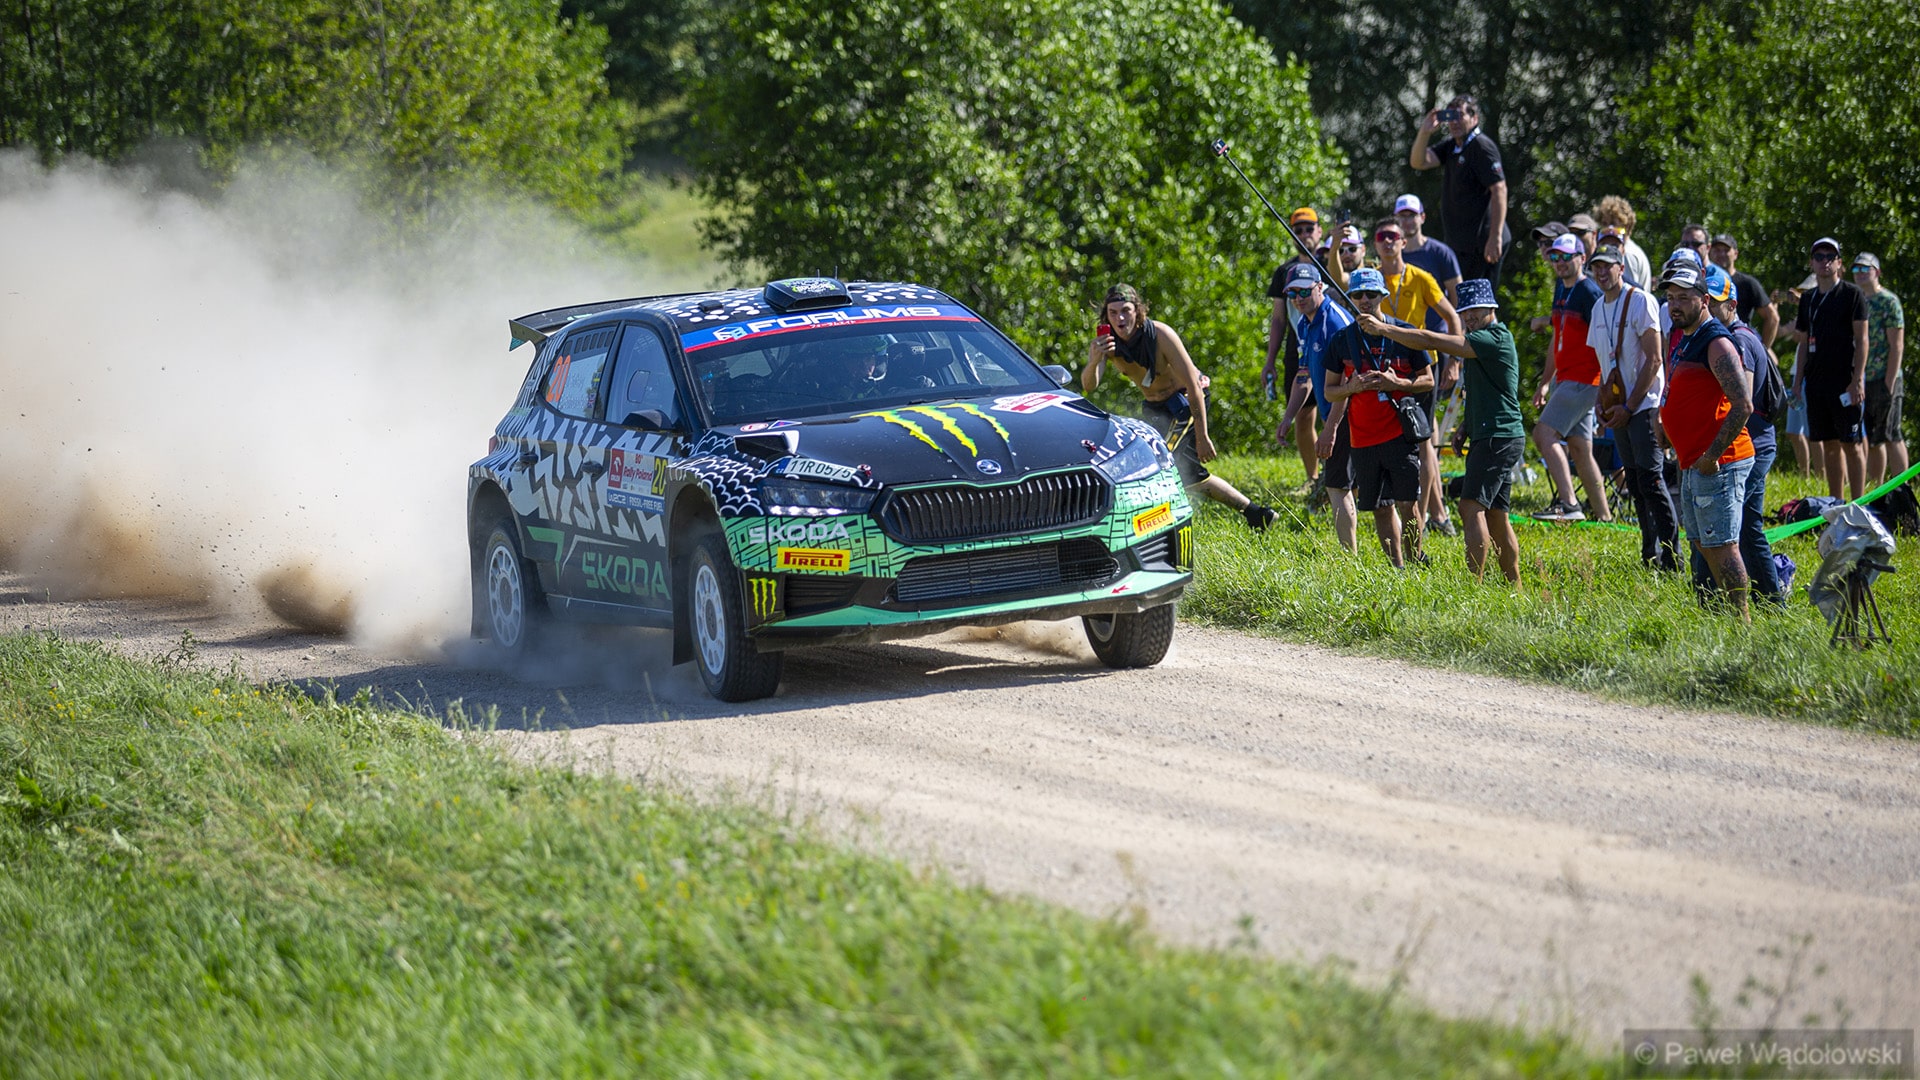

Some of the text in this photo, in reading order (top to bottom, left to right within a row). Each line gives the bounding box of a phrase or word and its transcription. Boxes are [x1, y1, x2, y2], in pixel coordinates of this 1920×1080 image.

[746, 306, 941, 332] FORUM8
[545, 355, 571, 402] 20
[652, 457, 667, 495] 20
[1138, 507, 1169, 531] PIRELLI
[784, 551, 844, 568] PIRELLI
